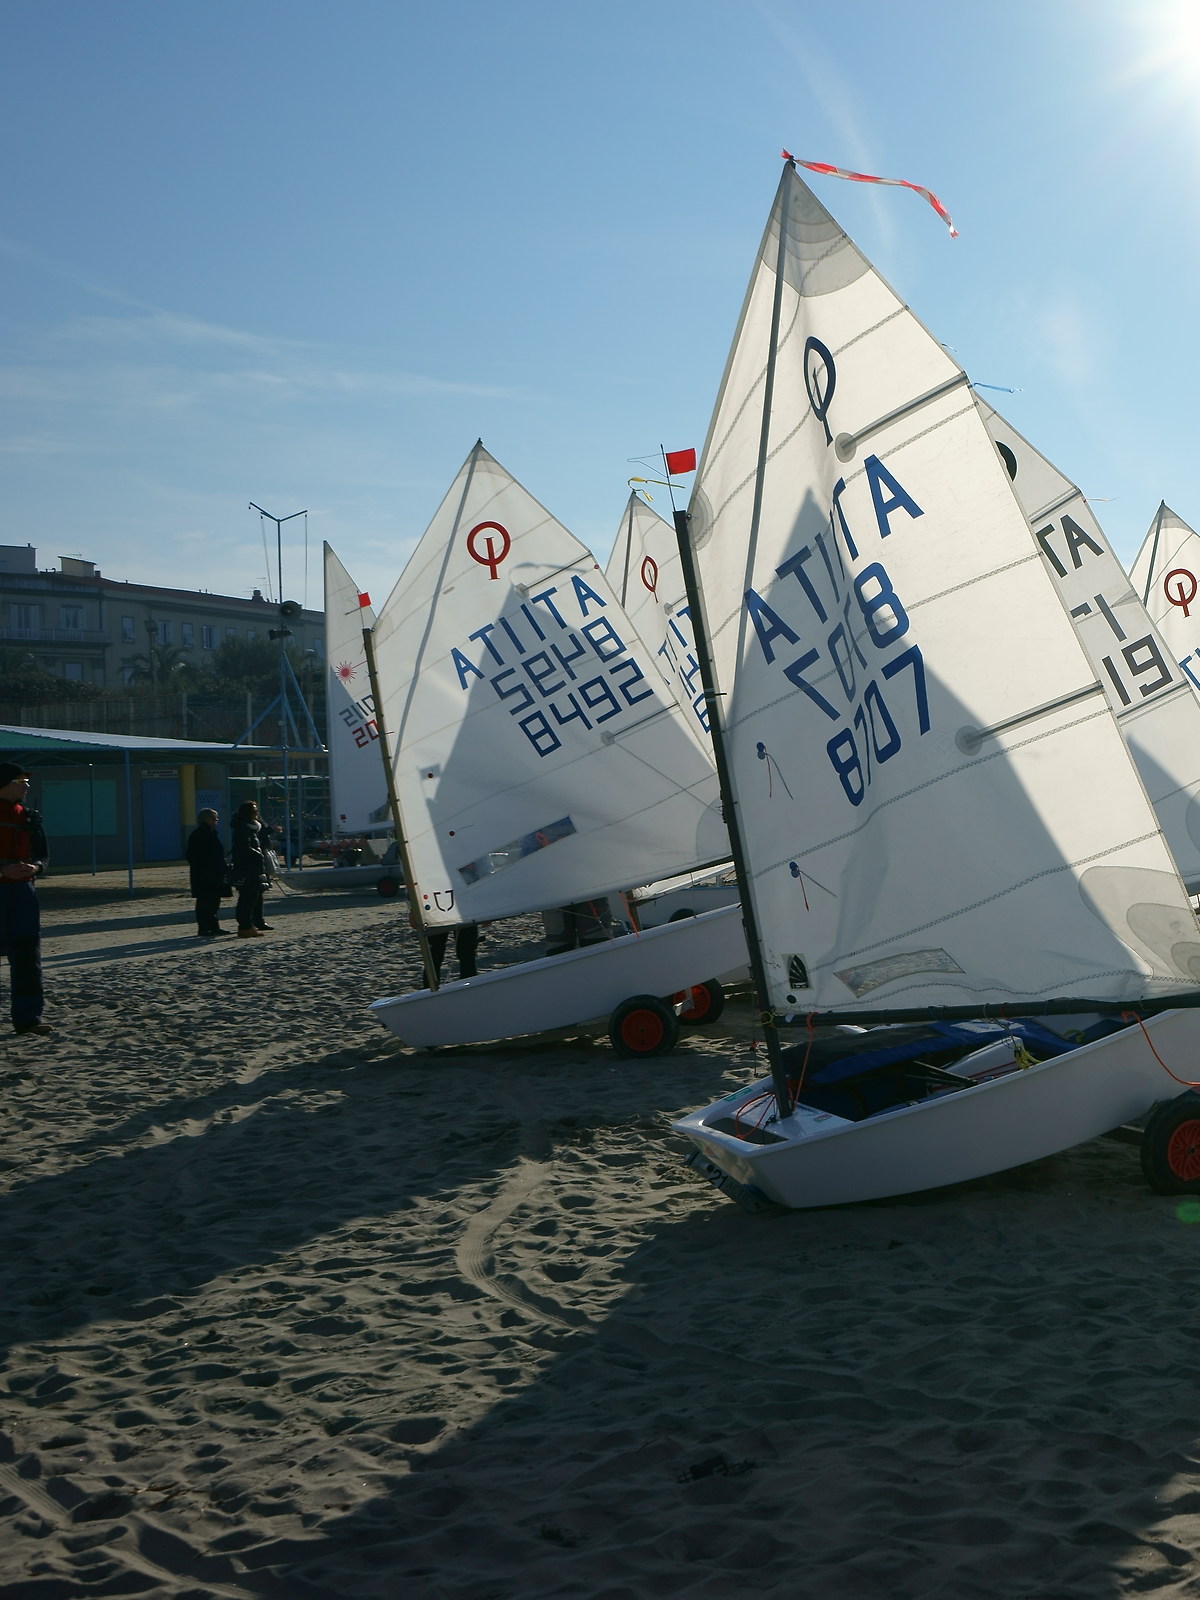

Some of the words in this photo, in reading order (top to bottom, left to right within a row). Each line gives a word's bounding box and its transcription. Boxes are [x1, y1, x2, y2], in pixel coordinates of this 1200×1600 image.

[518, 657, 655, 758] 8492
[1102, 633, 1174, 706] 19
[826, 644, 931, 806] 8707
